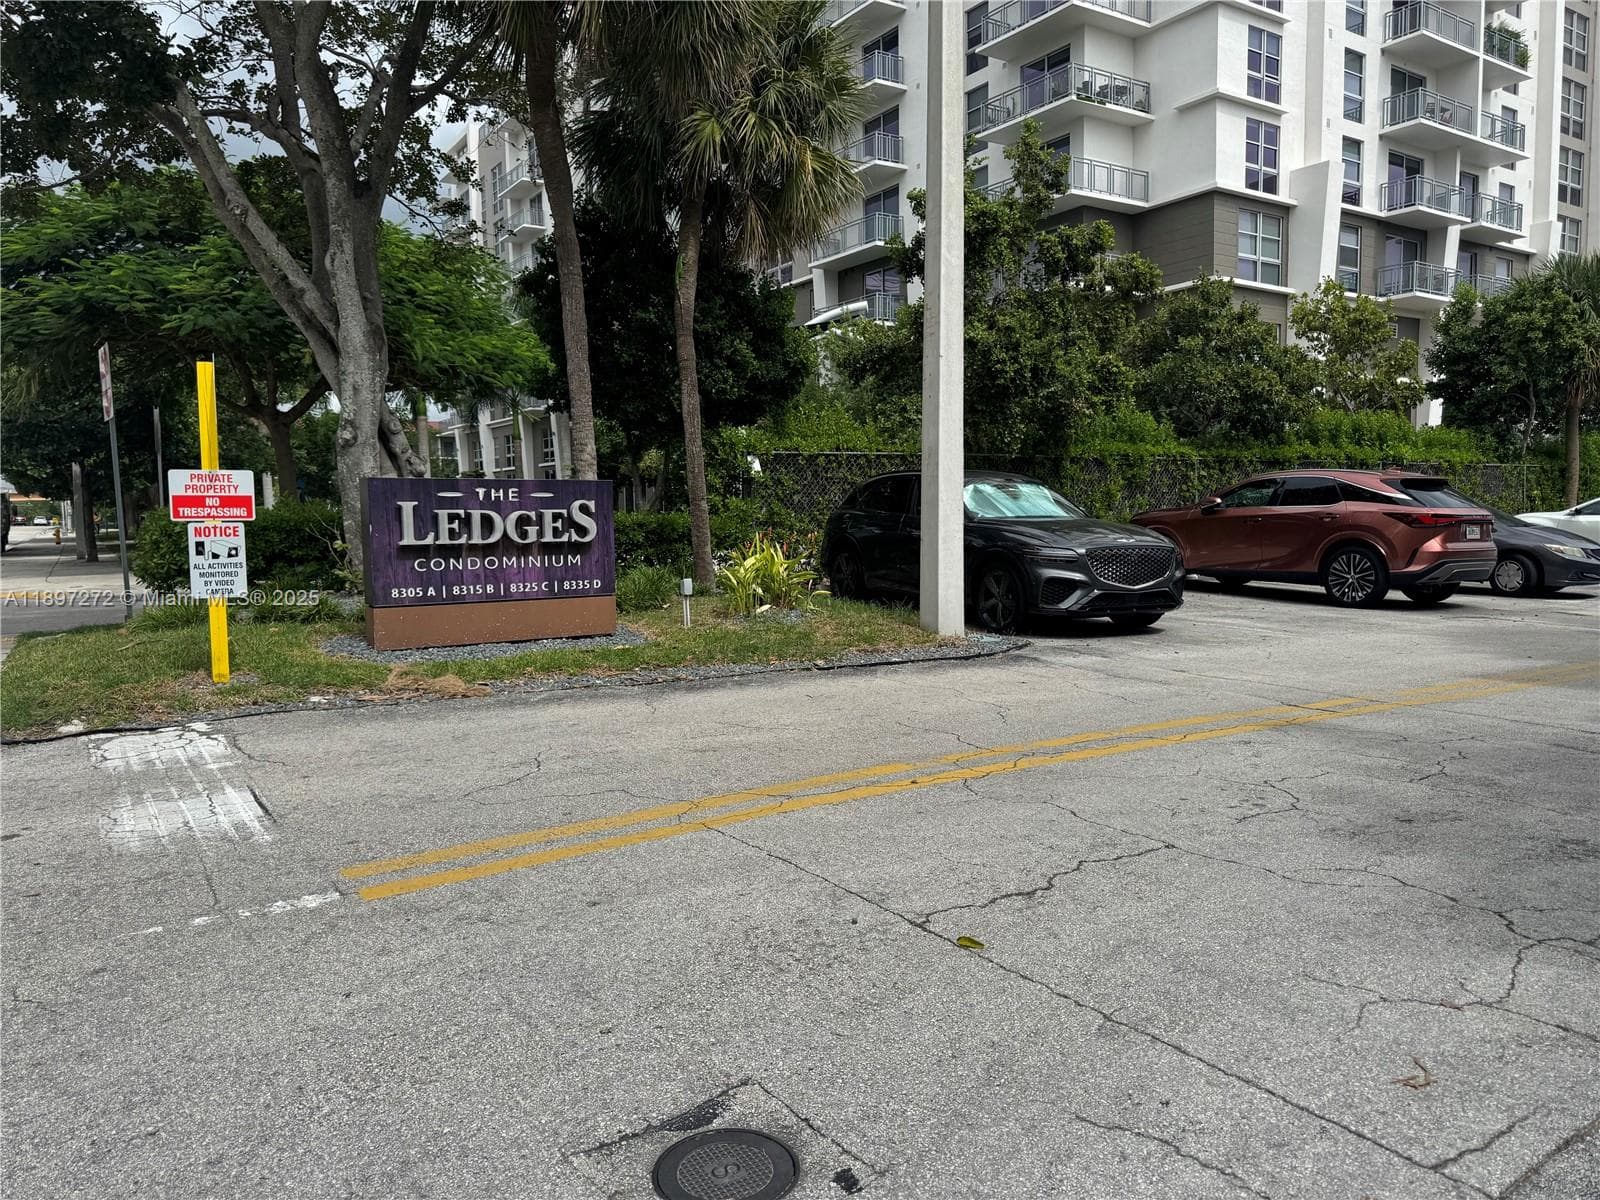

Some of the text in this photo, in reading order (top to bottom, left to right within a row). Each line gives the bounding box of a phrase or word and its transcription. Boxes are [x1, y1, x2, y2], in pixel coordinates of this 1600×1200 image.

[190, 473, 233, 483] PRIVATE
[184, 484, 240, 494] PROPERTY
[475, 487, 520, 502] THE
[205, 497, 220, 507] NO
[177, 507, 248, 517] TRESPASSING
[396, 499, 598, 546] LEDGES
[194, 525, 240, 538] NOTICE
[193, 561, 244, 570] ALL ACTIVITIES
[414, 554, 581, 572] CONDOMINIUM
[199, 570, 239, 579] MONITORED
[204, 579, 235, 587] BY VIDEO
[391, 587, 423, 599] 8305
[427, 586, 436, 597] A
[452, 584, 483, 596] 8315
[486, 584, 495, 594] B
[510, 582, 538, 593] 8325
[541, 581, 549, 592] C
[563, 580, 590, 590] 8335
[593, 579, 601, 589] D
